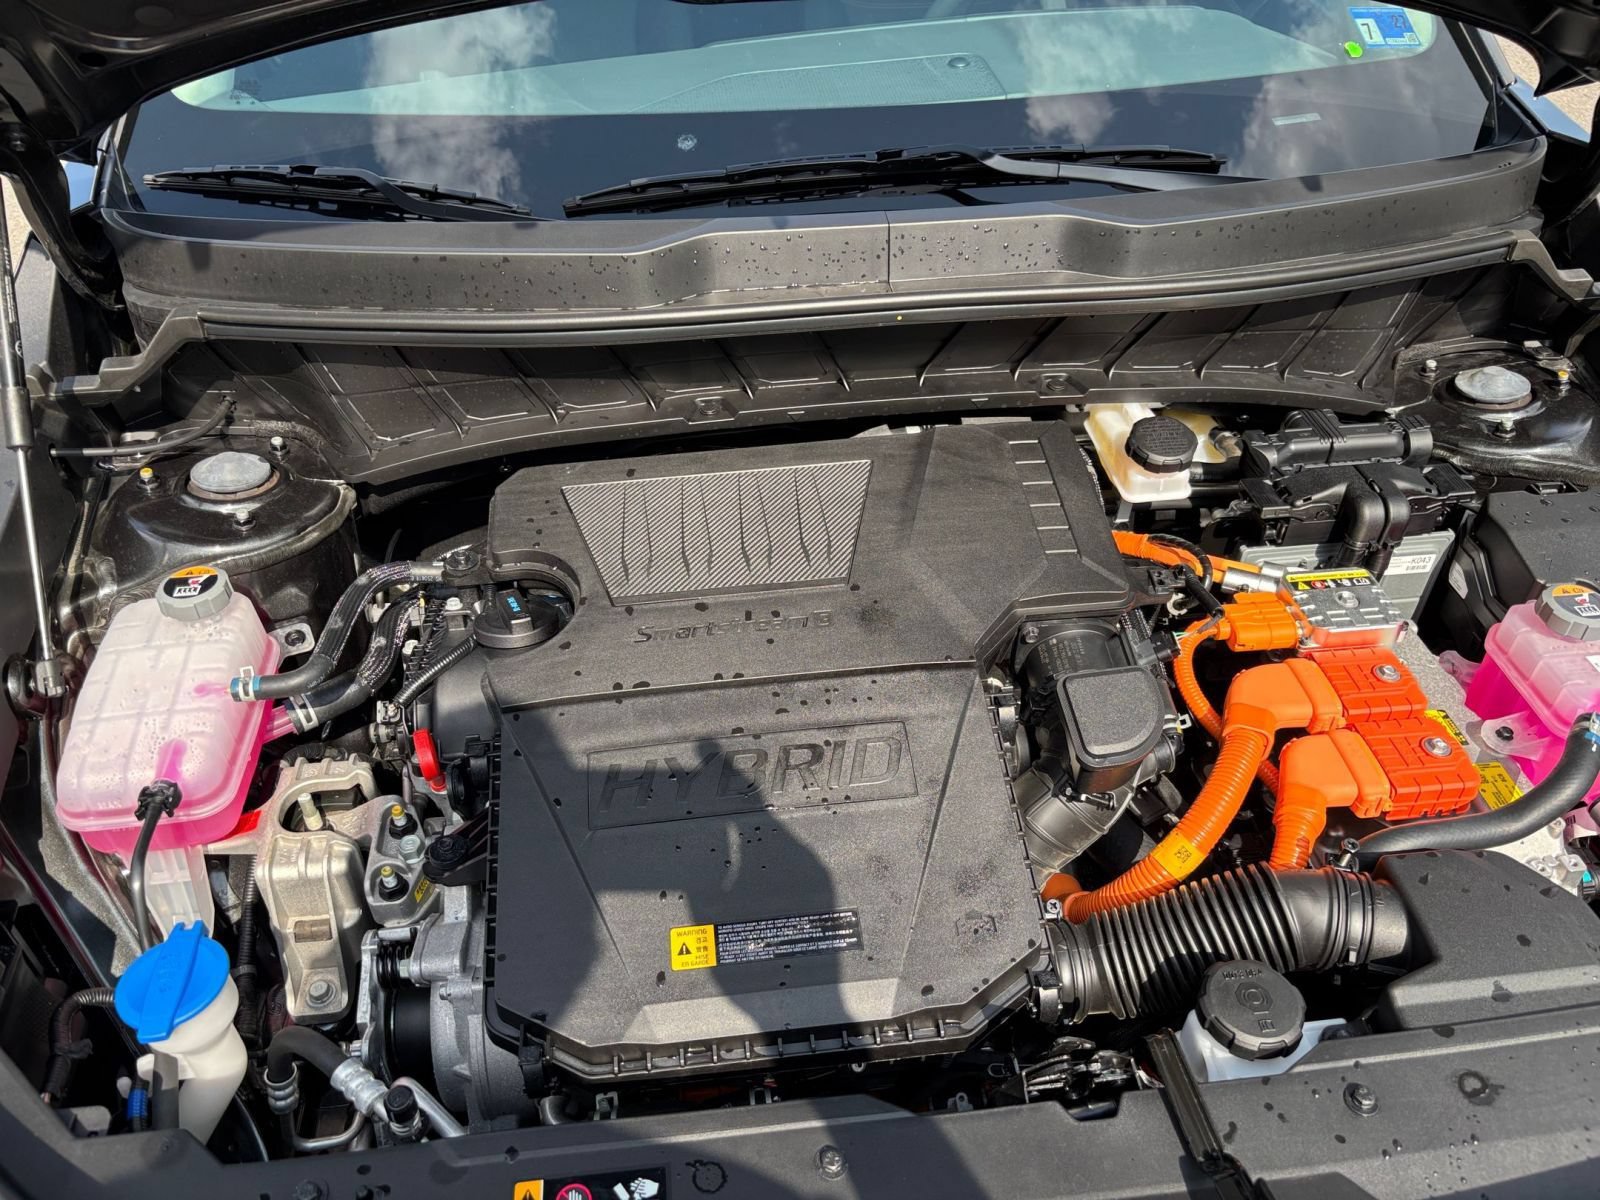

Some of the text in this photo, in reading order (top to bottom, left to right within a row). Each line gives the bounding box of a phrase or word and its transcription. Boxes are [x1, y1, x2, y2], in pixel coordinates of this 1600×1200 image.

[1361, 23, 1373, 40] 7
[599, 736, 903, 813] HYBRID
[676, 928, 708, 937] WARNING
